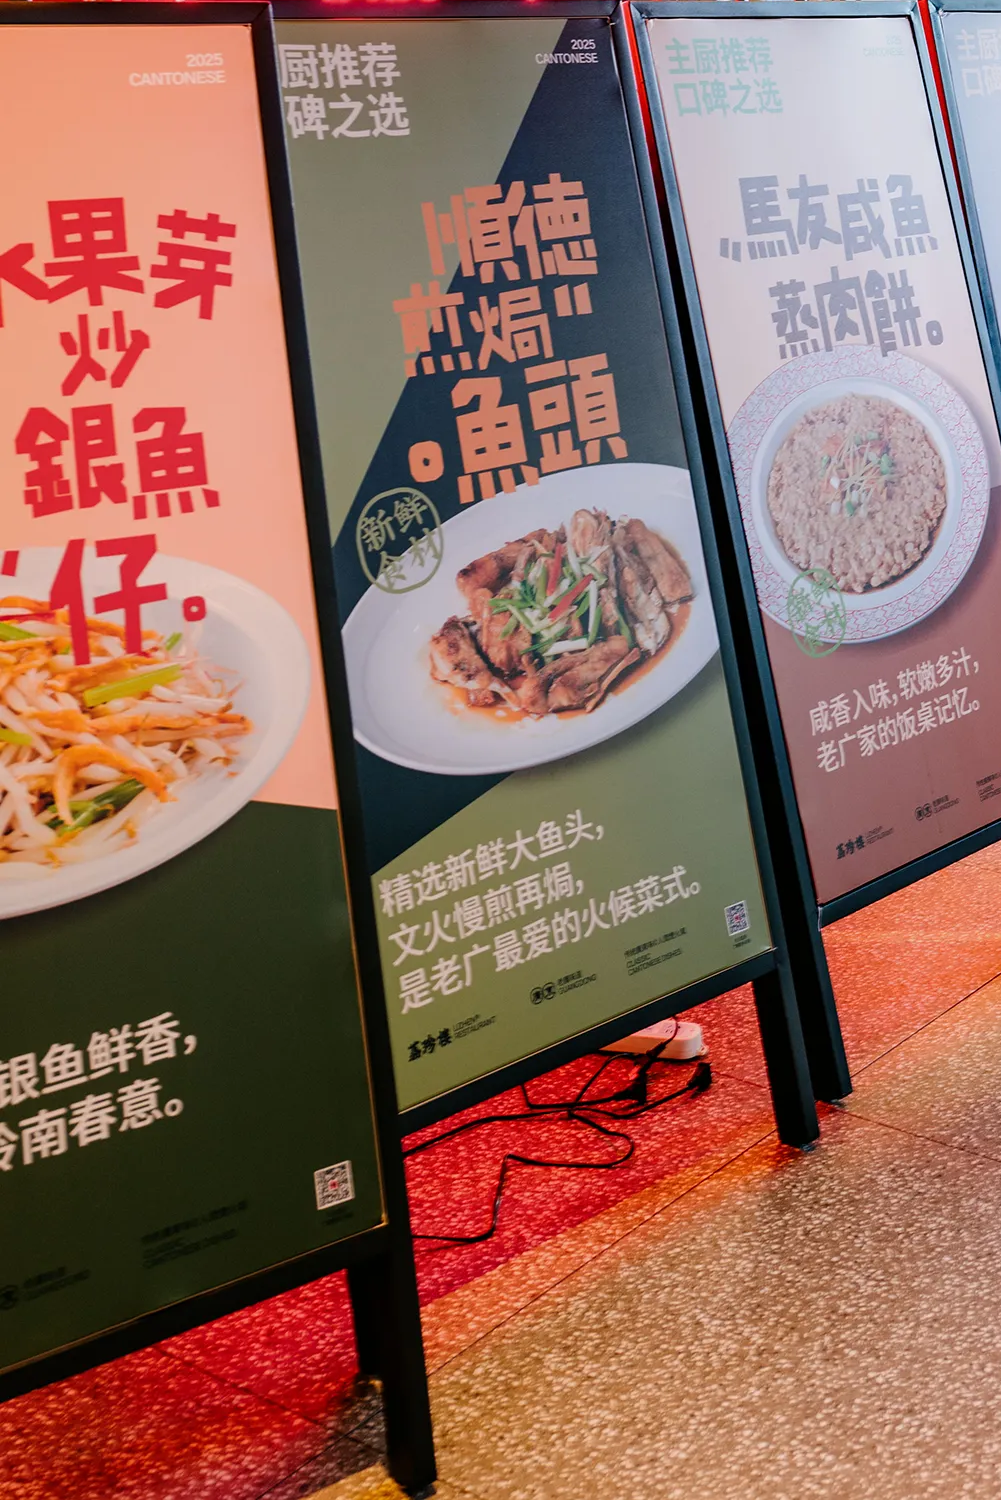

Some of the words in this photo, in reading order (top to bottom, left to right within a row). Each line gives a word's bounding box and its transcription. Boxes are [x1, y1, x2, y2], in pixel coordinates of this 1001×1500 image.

[186, 53, 224, 68] 2025
[277, 43, 401, 90] 厨推荐
[535, 51, 599, 66] CANTONESE
[571, 38, 596, 50] 2025
[665, 36, 774, 76] 主厨推荐
[128, 69, 227, 88] CANTONESE
[673, 77, 784, 118] 口碑之选
[284, 93, 411, 141] 碑之选
[59, 310, 151, 397] 炒
[14, 403, 221, 521] 銀魚
[815, 686, 981, 773] 老广家的饭桌记忆。
[378, 808, 606, 919] 精选新鲜大鱼头，
[397, 865, 702, 1015] 是老广最爱的火候菜式。
